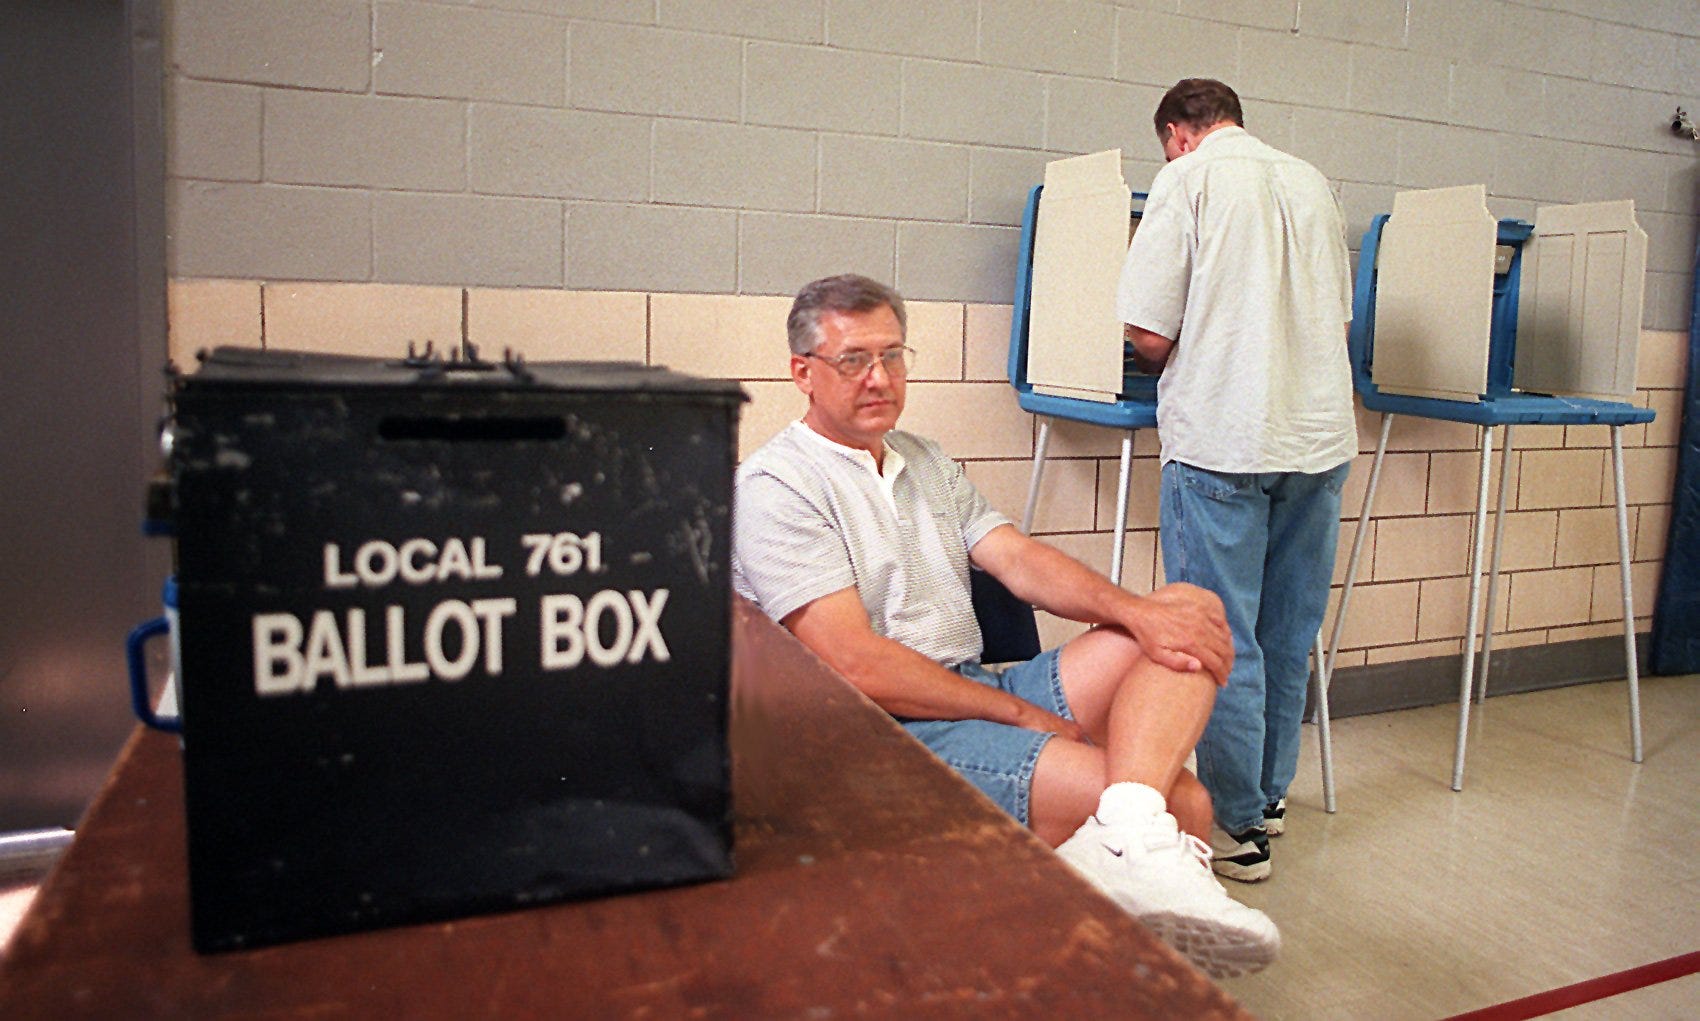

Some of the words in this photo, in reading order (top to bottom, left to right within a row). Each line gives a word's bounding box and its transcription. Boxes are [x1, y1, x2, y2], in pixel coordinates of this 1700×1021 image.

[324, 536, 503, 588] LOCAL
[521, 531, 603, 576] 761
[252, 598, 517, 696] BALLOT
[540, 588, 671, 671] BOX
